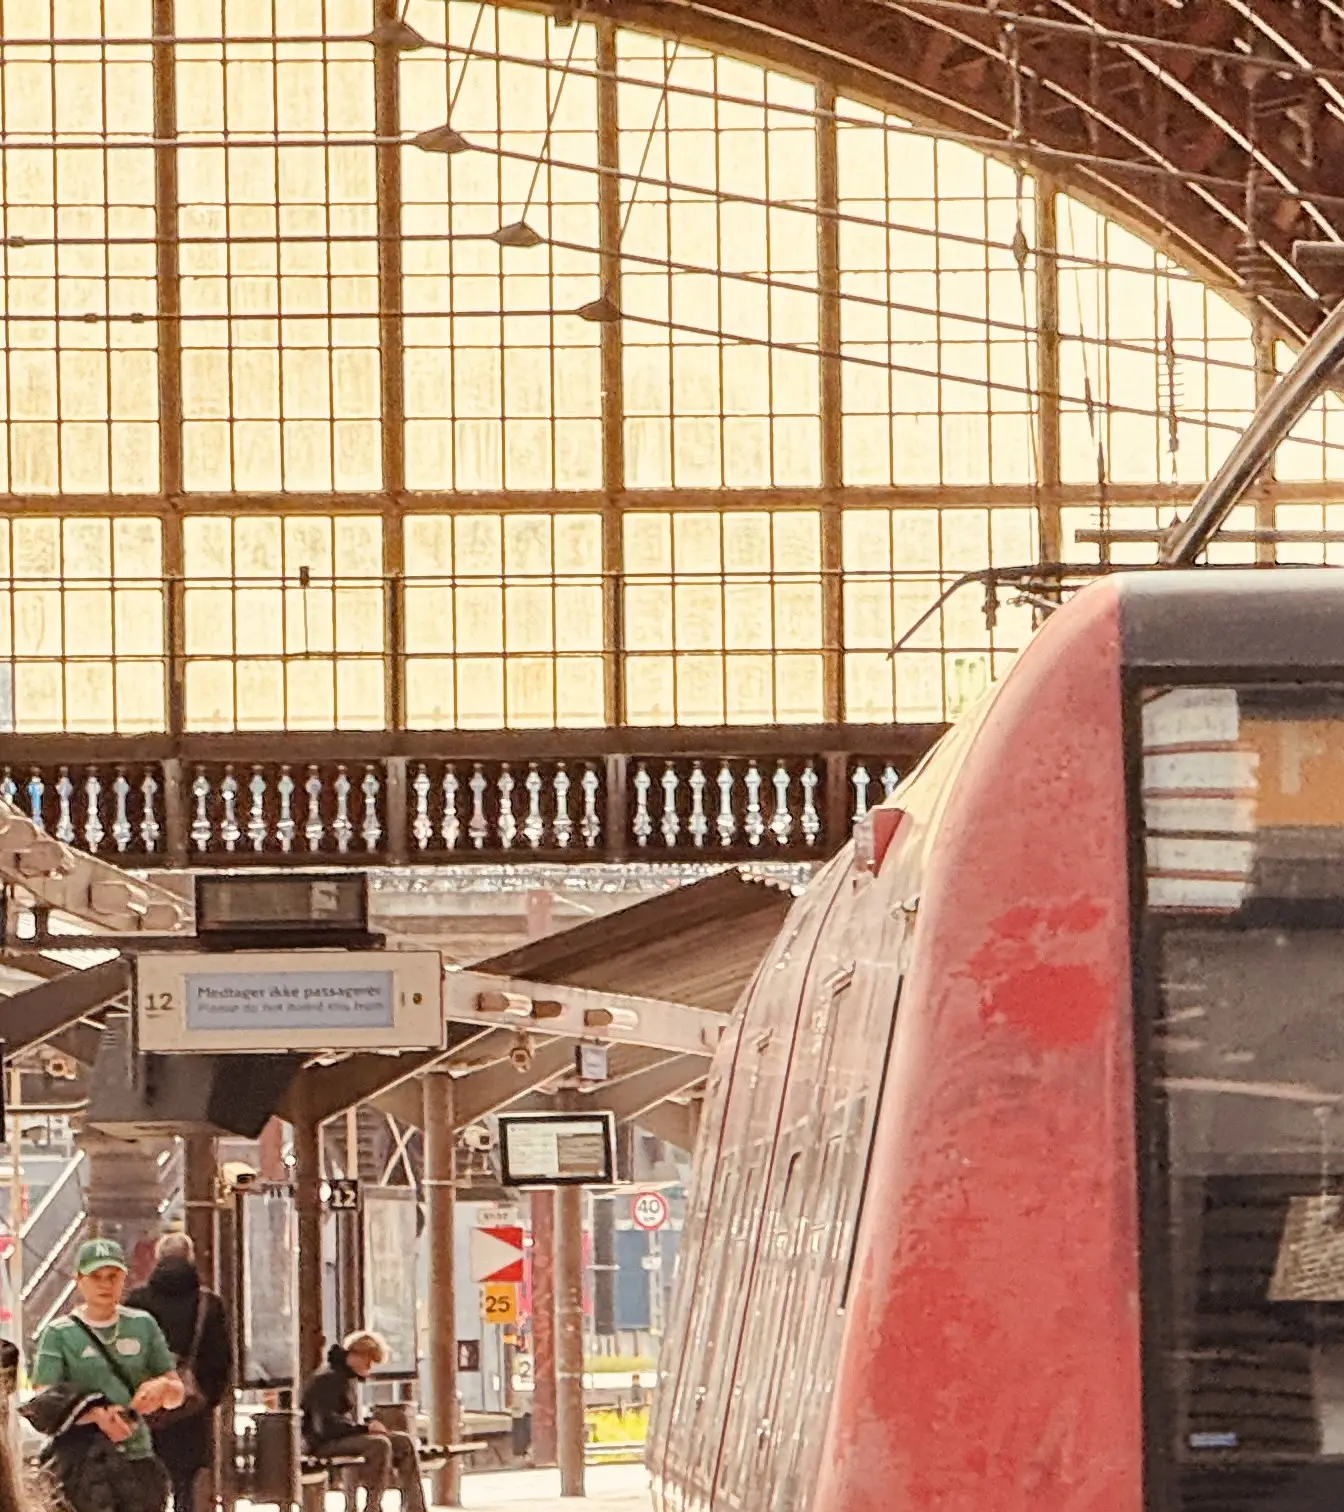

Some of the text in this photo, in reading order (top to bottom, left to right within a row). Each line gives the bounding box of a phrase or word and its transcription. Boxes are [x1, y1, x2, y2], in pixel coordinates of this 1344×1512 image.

[145, 993, 174, 1010] 12
[331, 1189, 356, 1208] 12
[637, 1199, 660, 1214] 40
[485, 1295, 511, 1313] 25
